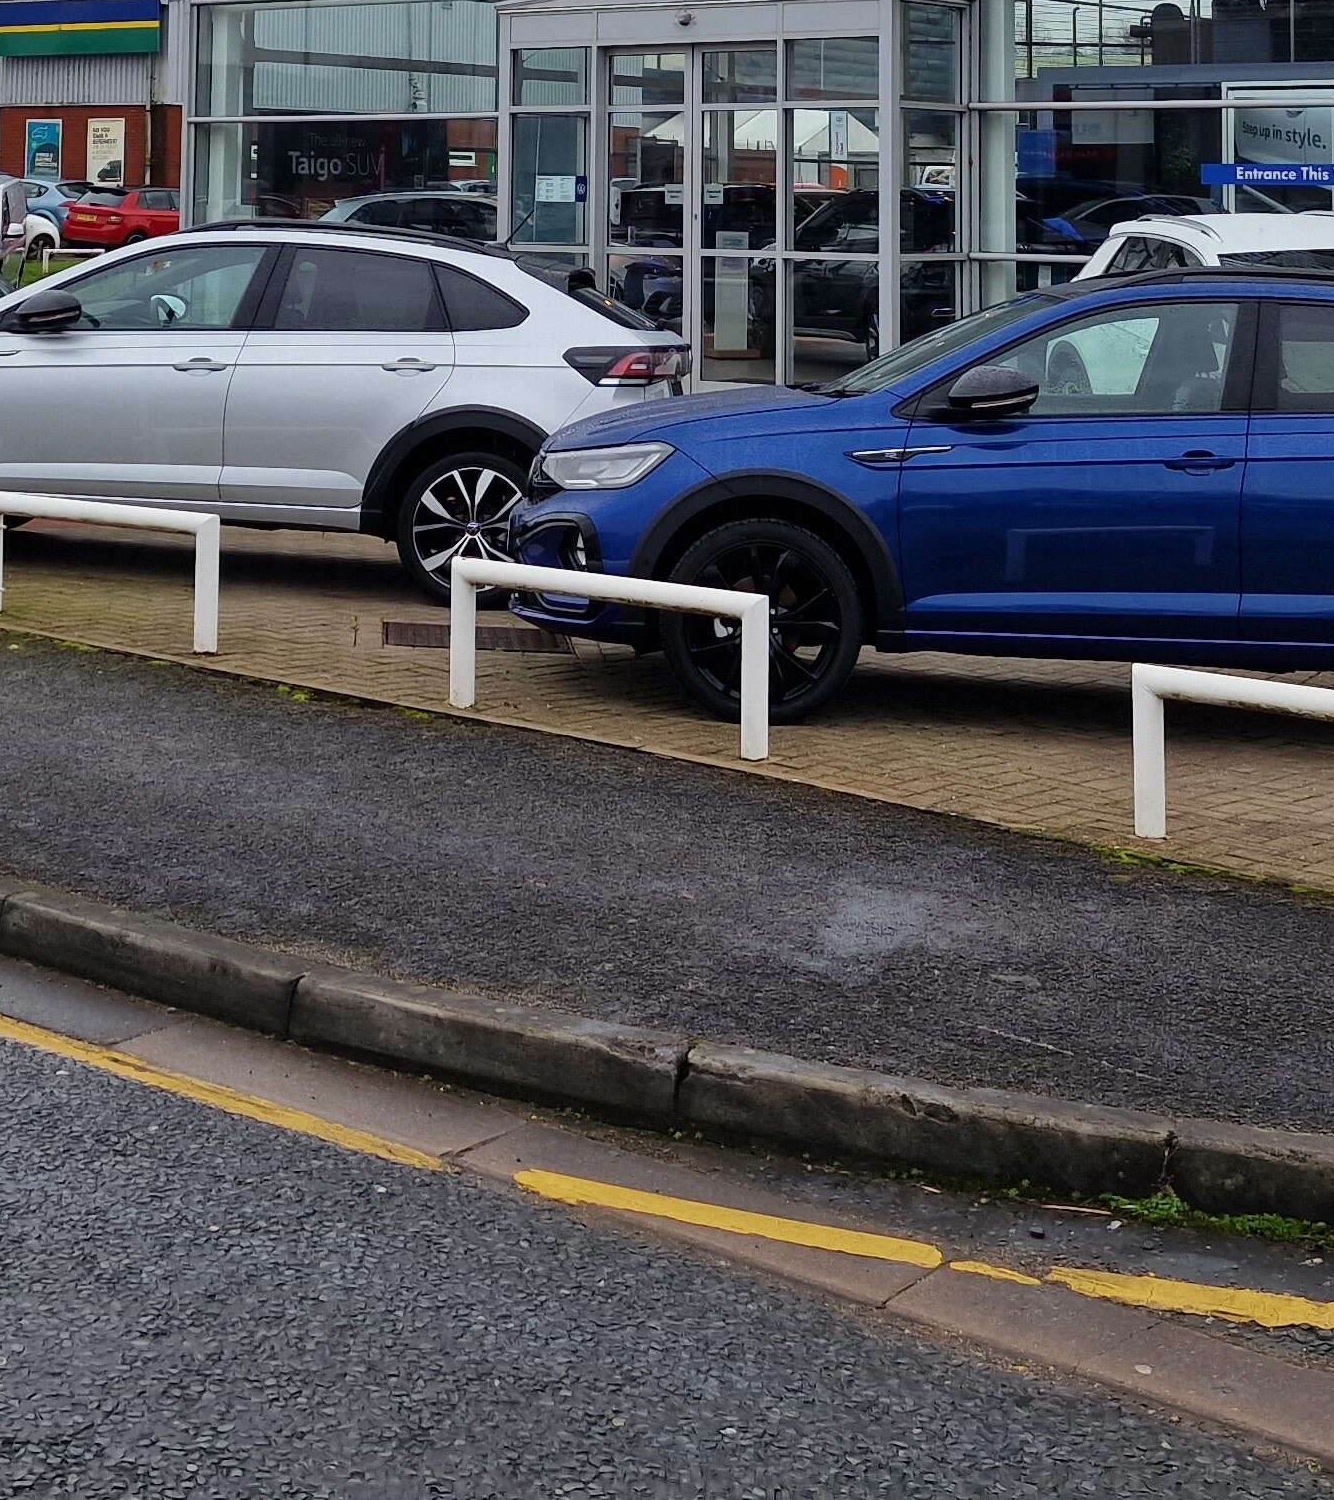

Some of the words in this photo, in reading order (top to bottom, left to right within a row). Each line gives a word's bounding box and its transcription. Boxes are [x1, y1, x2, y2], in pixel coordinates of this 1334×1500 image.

[309, 133, 327, 146] The
[1242, 121, 1258, 136] Step
[1259, 124, 1271, 141] up
[1272, 123, 1283, 141] in
[1285, 127, 1327, 150] style.
[287, 151, 342, 181] Taigo
[346, 152, 384, 176] SUV
[1235, 166, 1296, 181] Entrance
[1300, 166, 1329, 181] This
